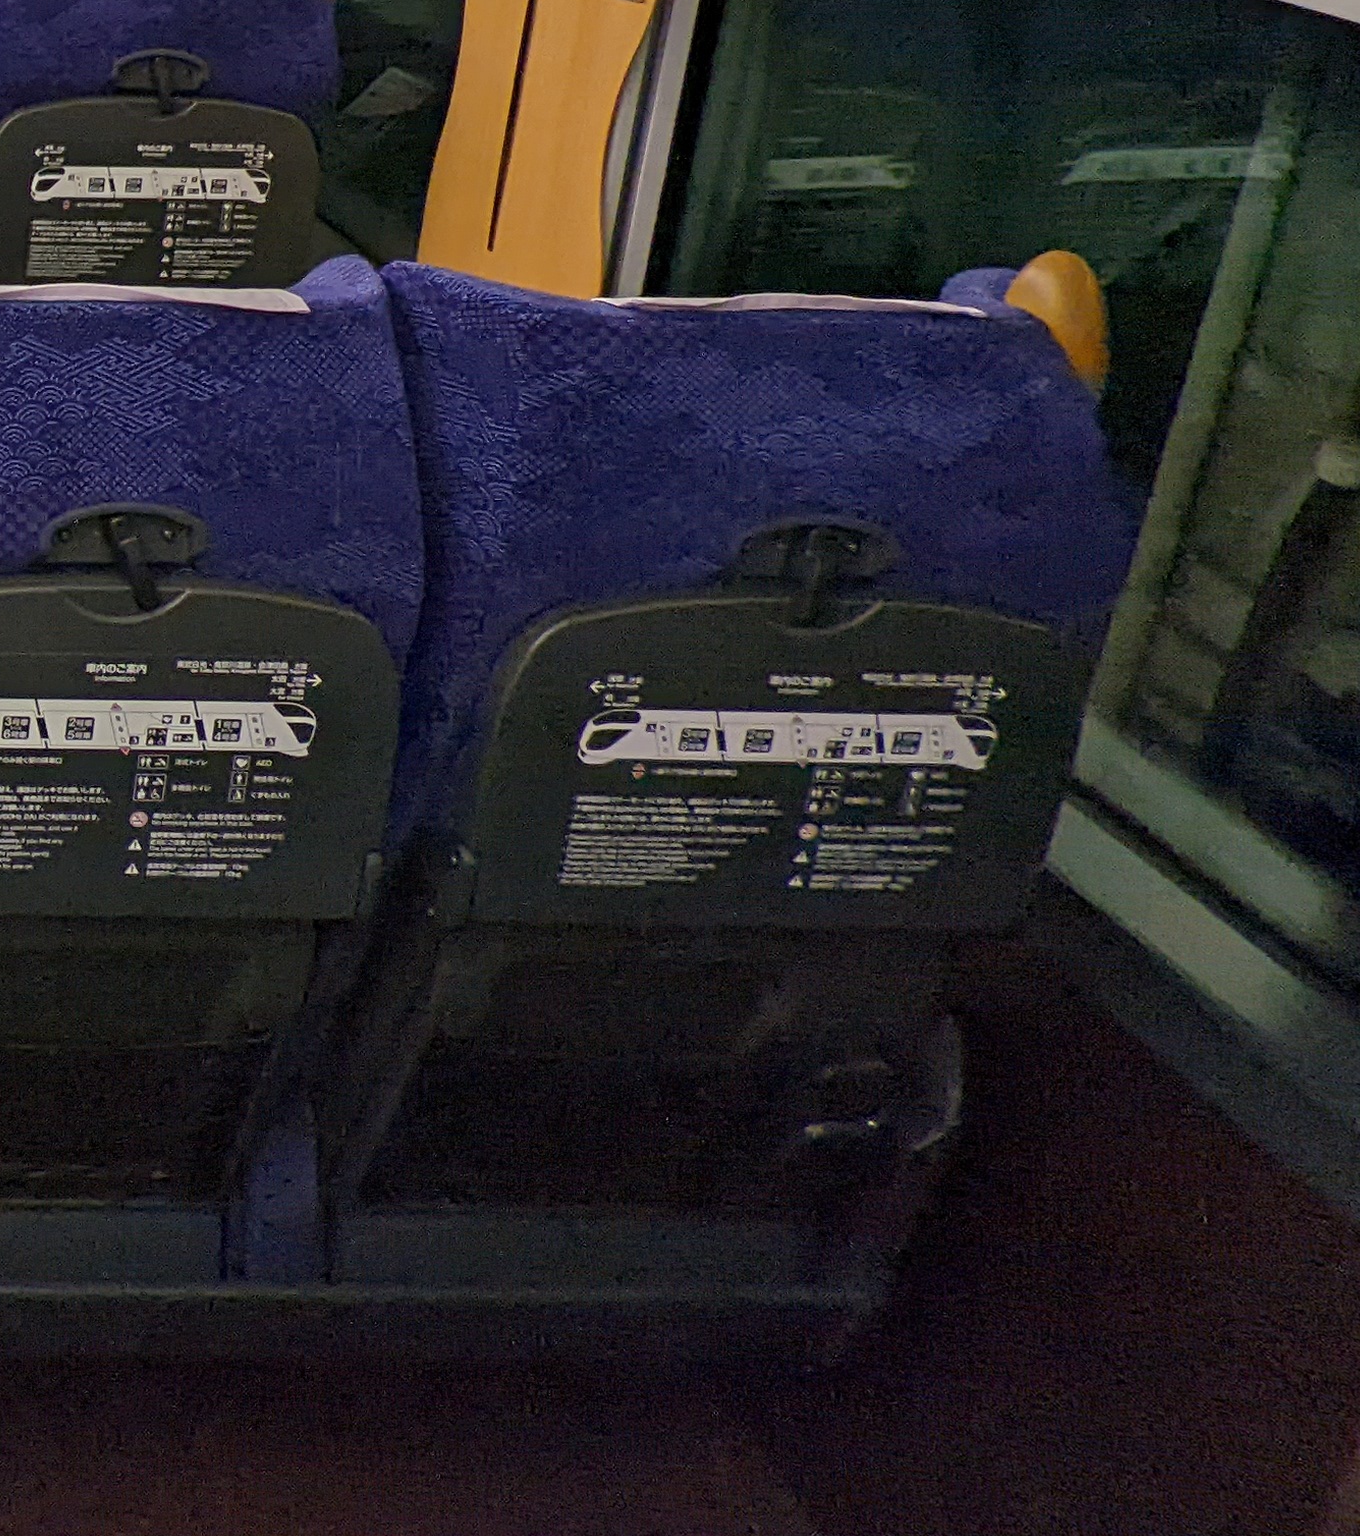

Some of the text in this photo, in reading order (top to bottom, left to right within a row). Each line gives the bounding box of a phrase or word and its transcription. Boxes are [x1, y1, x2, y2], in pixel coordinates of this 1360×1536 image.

[85, 663, 147, 675] 車内のご案内
